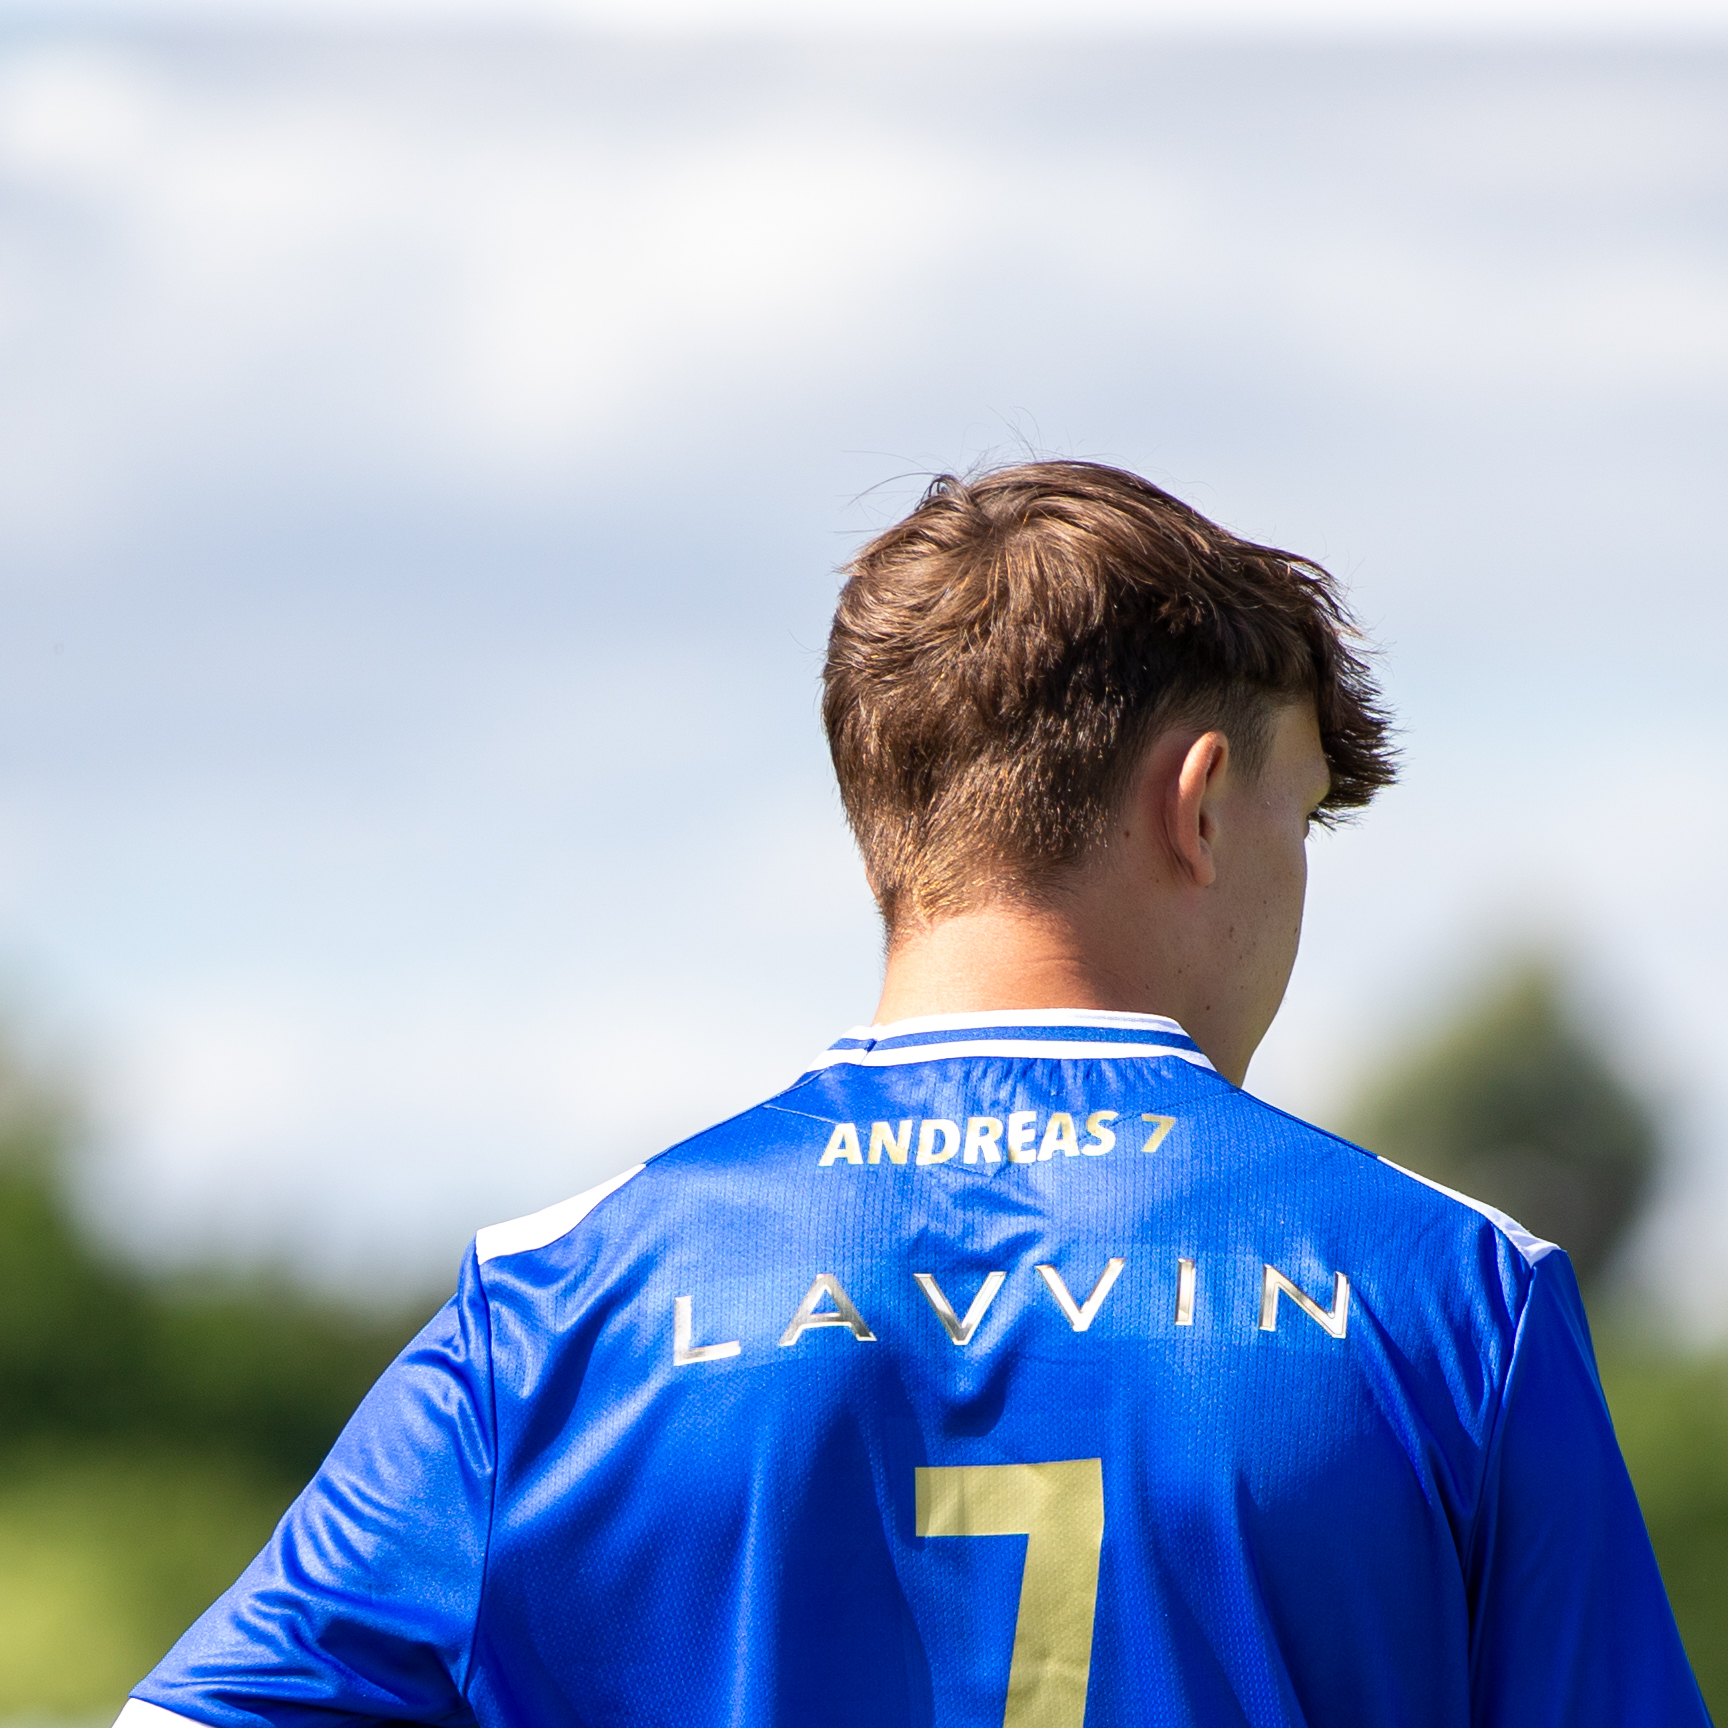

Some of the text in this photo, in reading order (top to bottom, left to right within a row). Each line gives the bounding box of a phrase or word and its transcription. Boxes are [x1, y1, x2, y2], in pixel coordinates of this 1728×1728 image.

[818, 1110, 1176, 1167] ANDREAS 7
[673, 1257, 1350, 1366] LAVVIN
